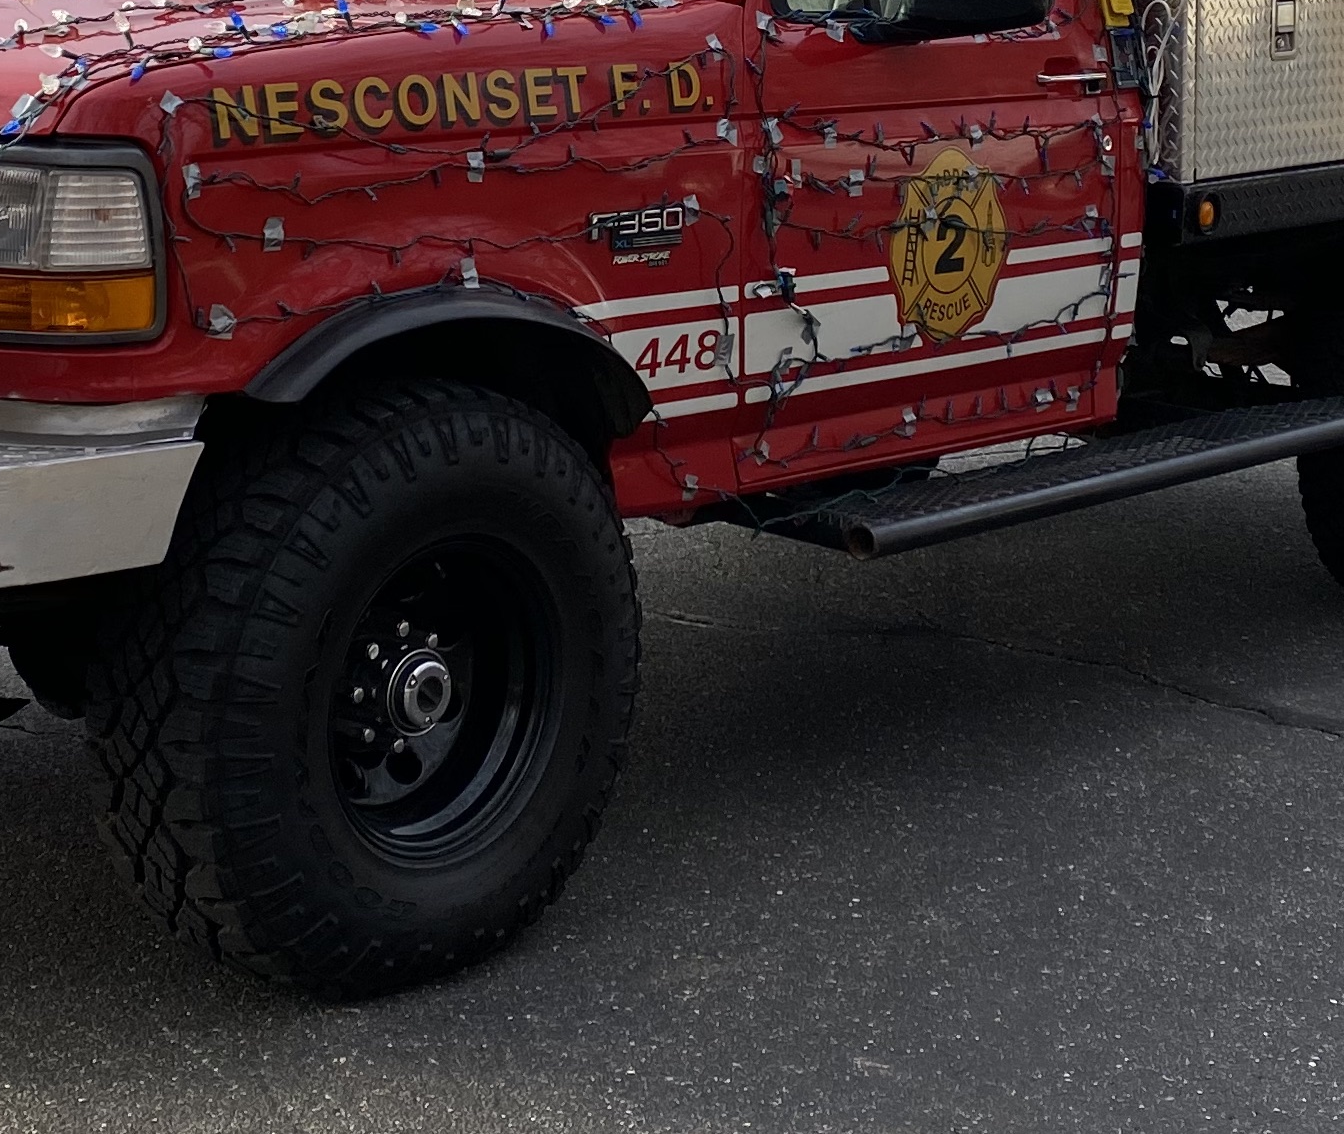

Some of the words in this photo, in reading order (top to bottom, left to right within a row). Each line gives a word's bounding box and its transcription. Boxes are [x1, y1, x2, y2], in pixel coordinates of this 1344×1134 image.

[211, 65, 588, 141] NESCONSET
[614, 239, 632, 249] XL
[934, 213, 968, 275] 2
[923, 292, 972, 322] RESCUE
[635, 329, 723, 379] 448
